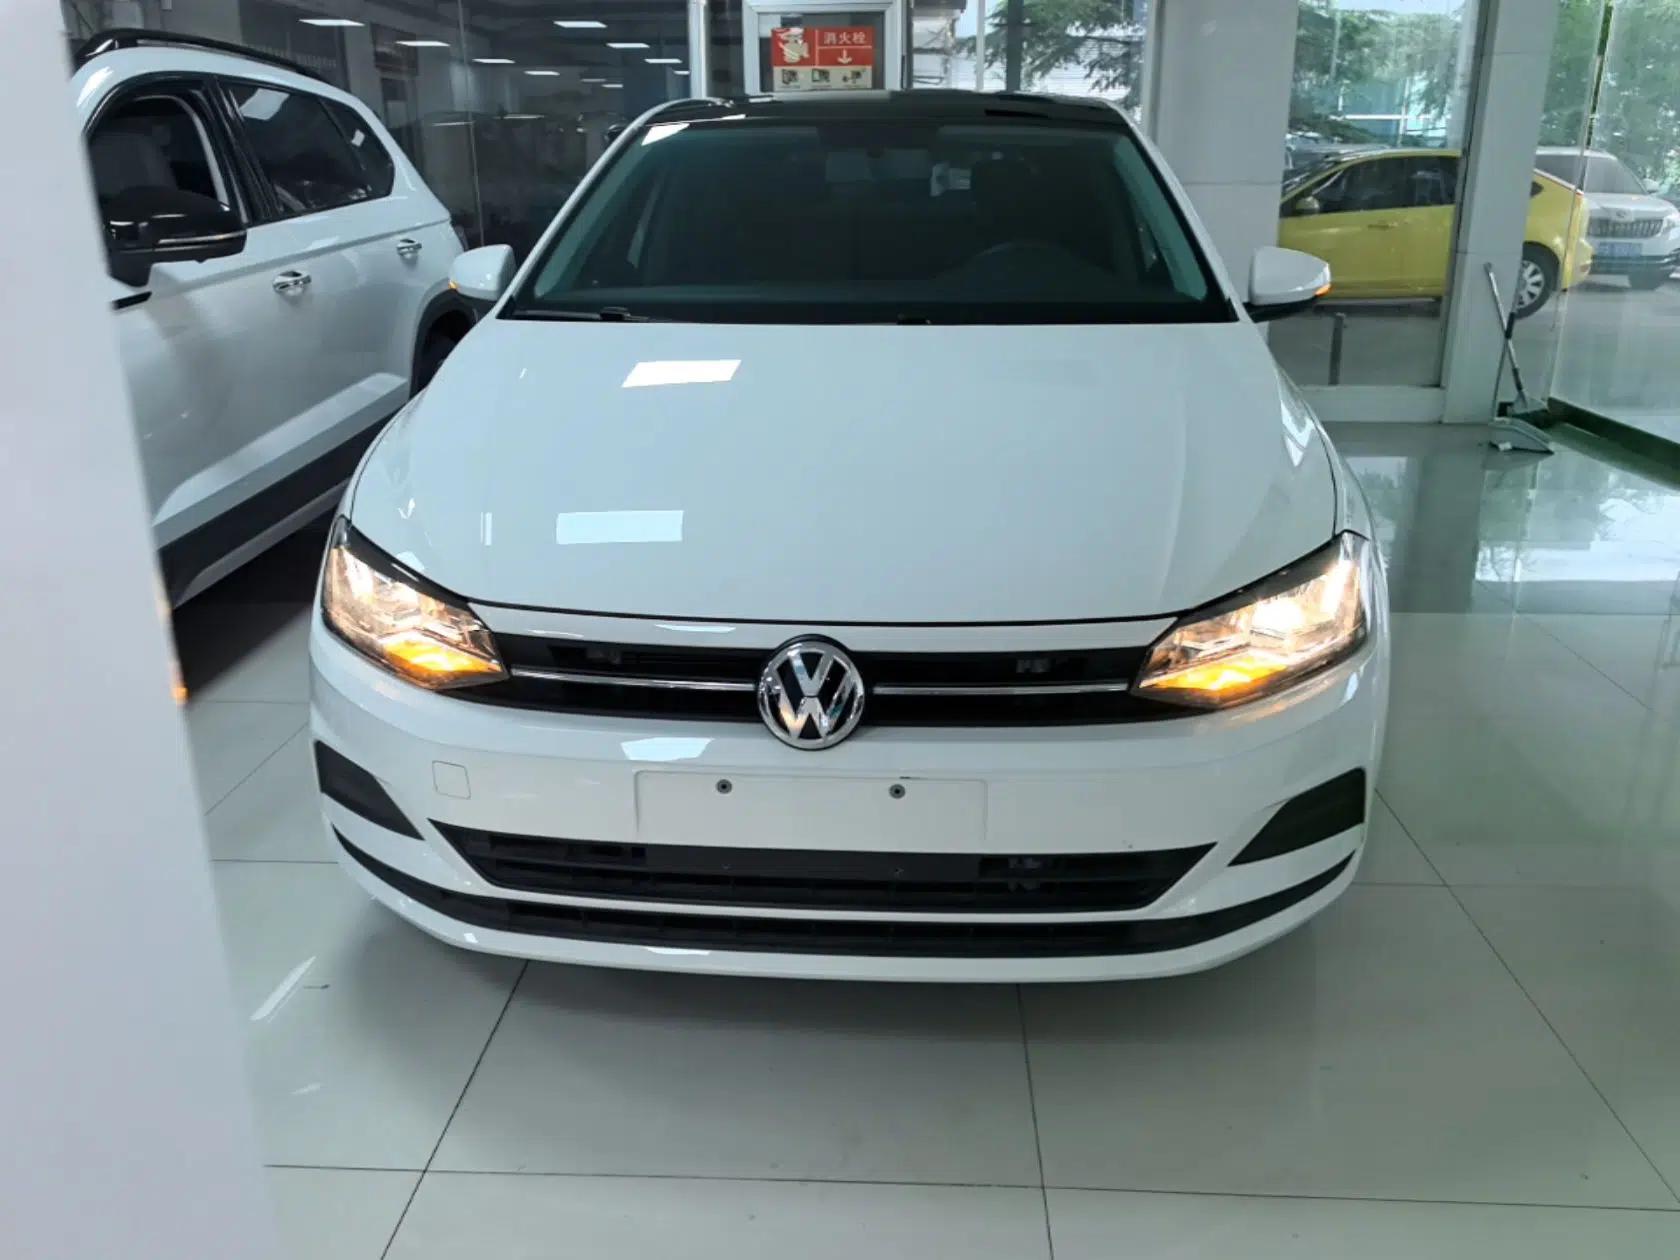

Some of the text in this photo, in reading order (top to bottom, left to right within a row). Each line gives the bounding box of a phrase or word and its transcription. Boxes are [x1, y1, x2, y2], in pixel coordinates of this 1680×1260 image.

[823, 31, 866, 45] 消火栓
[766, 644, 859, 745] VW
